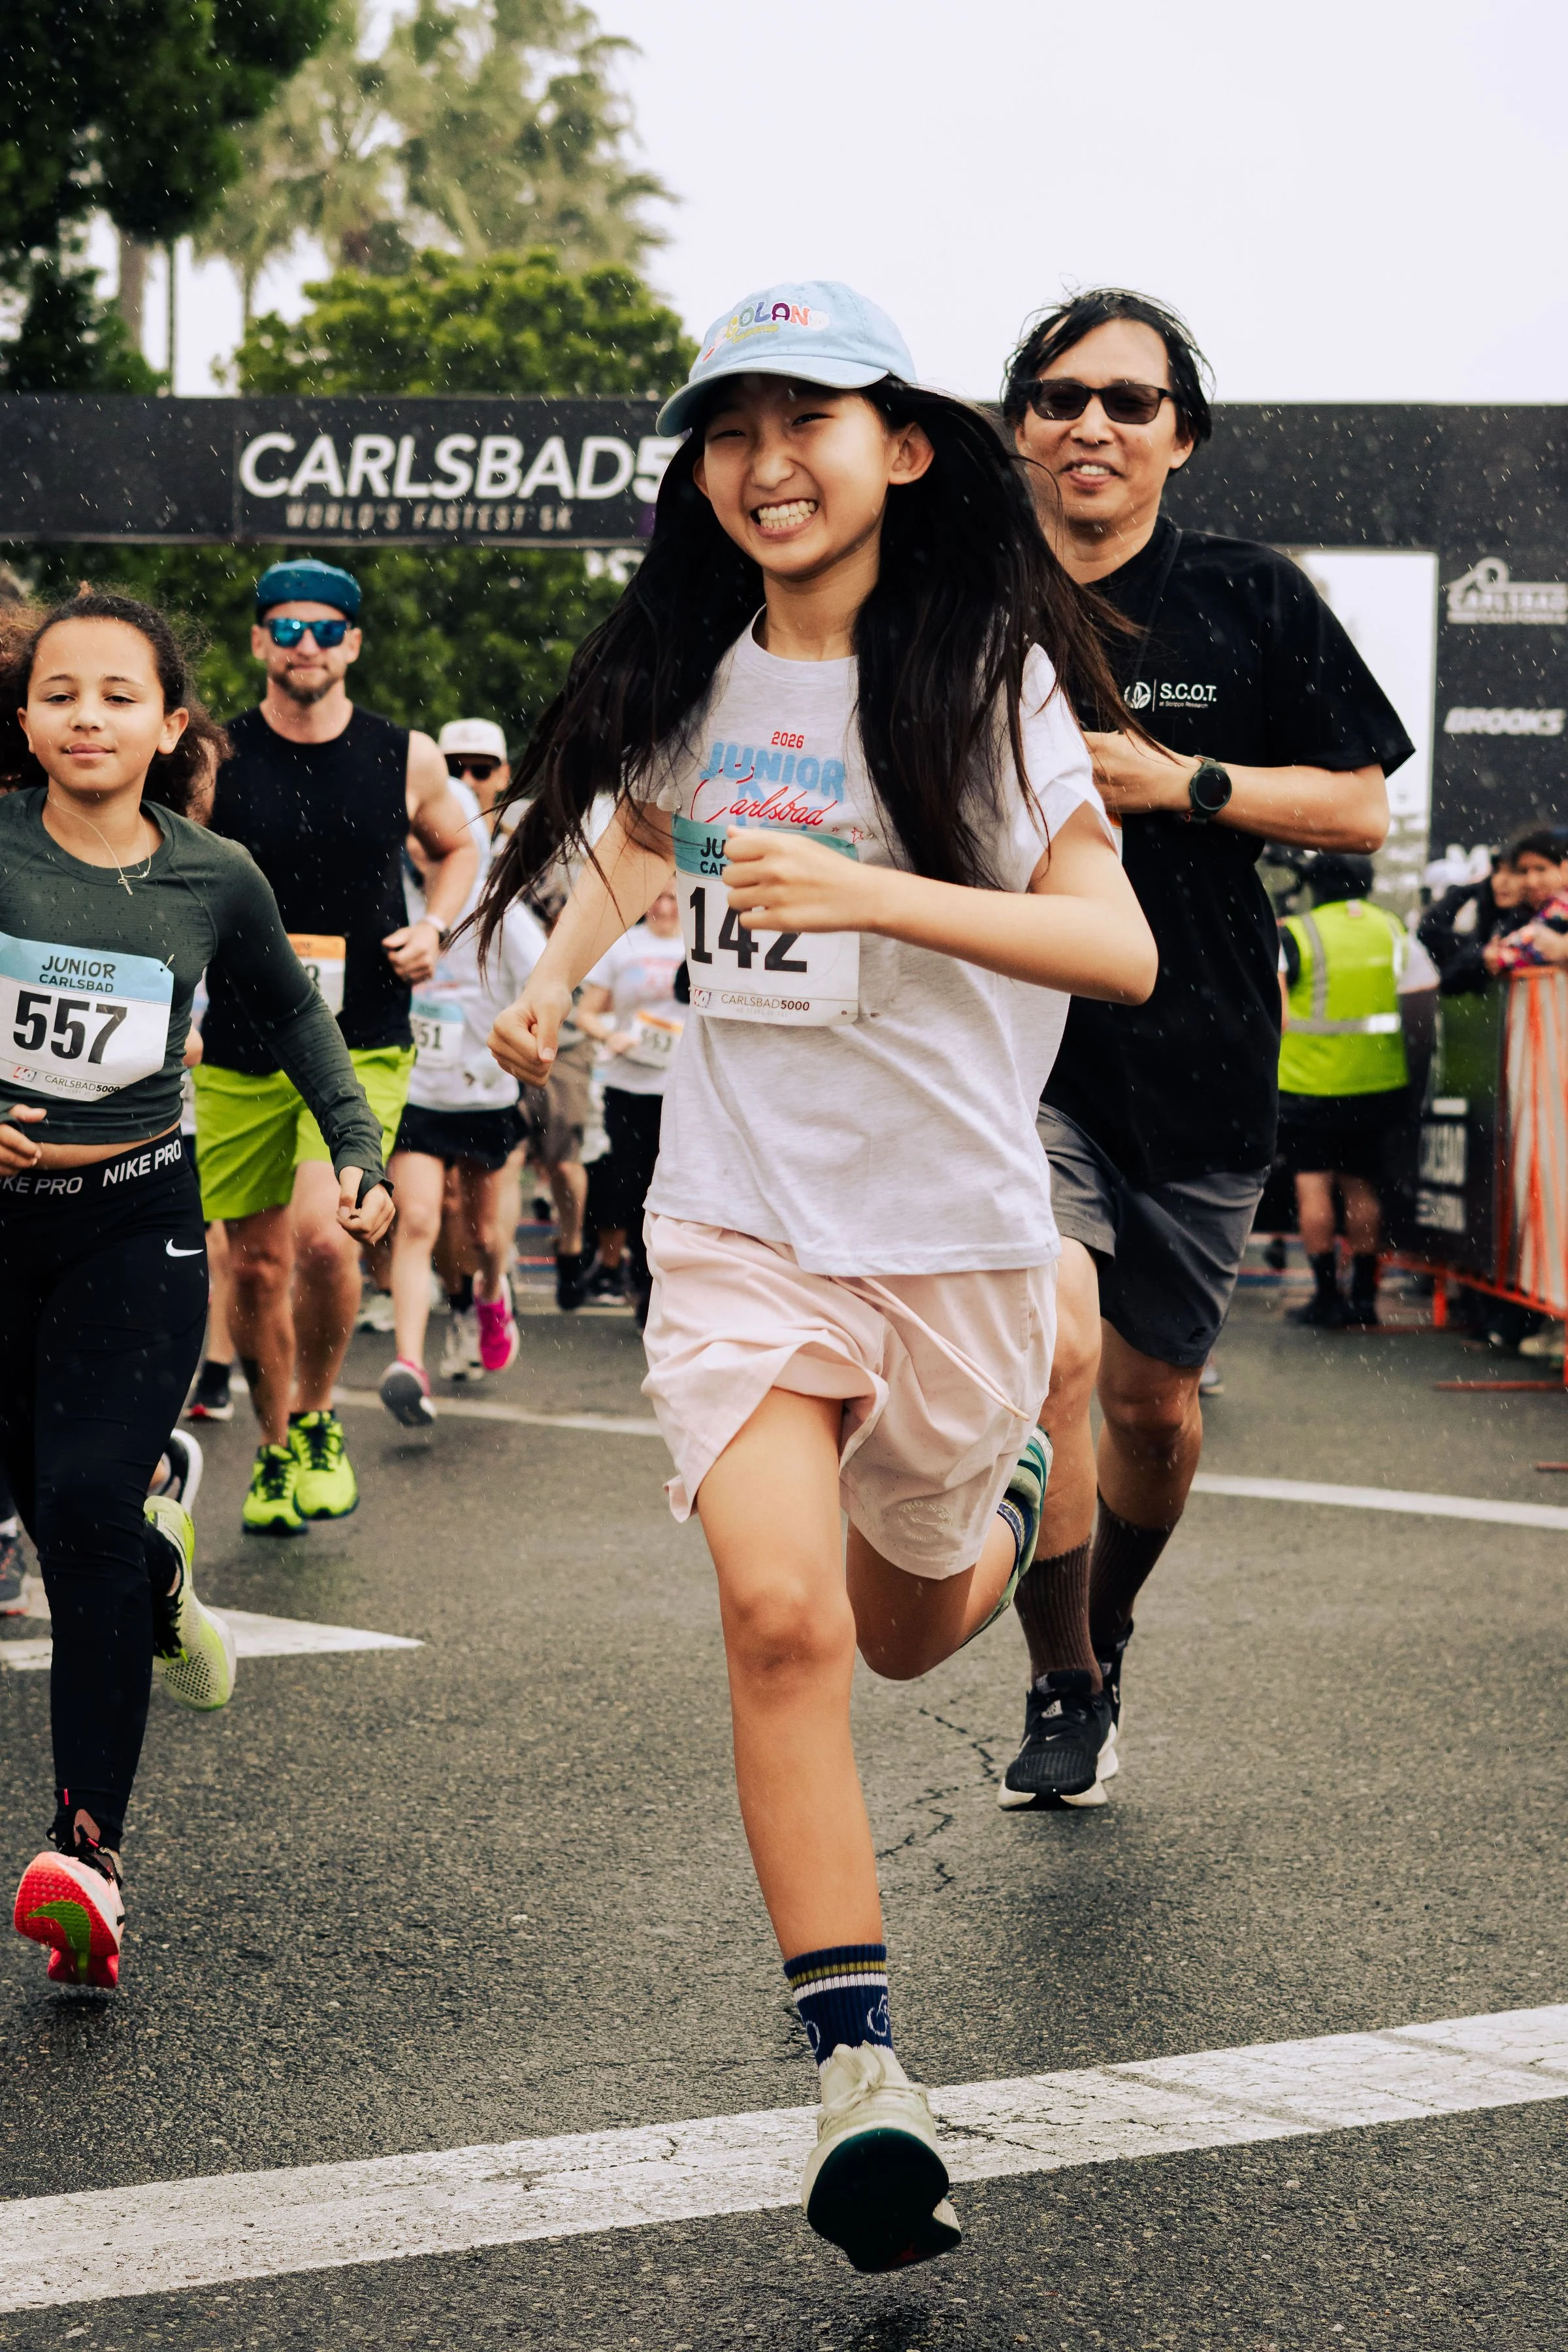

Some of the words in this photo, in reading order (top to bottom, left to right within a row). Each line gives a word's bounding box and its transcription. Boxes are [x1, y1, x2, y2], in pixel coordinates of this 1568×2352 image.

[286, 502, 401, 530] WORLD'S
[412, 504, 525, 531] FASTEST
[1160, 683, 1217, 702] S.C.O.T.
[771, 731, 804, 749] 2026
[700, 741, 845, 802] JUNIOR
[691, 763, 838, 826] Carlsbad
[42, 955, 116, 979] JUNIOR
[39, 974, 114, 993] CARLSBAD
[721, 994, 809, 1011] CARLSBAD5000
[13, 990, 127, 1064] 557
[103, 1154, 152, 1187] NIKE
[154, 1139, 182, 1168] PRO
[2, 1177, 32, 1194] KE
[35, 1177, 83, 1194] PRO
